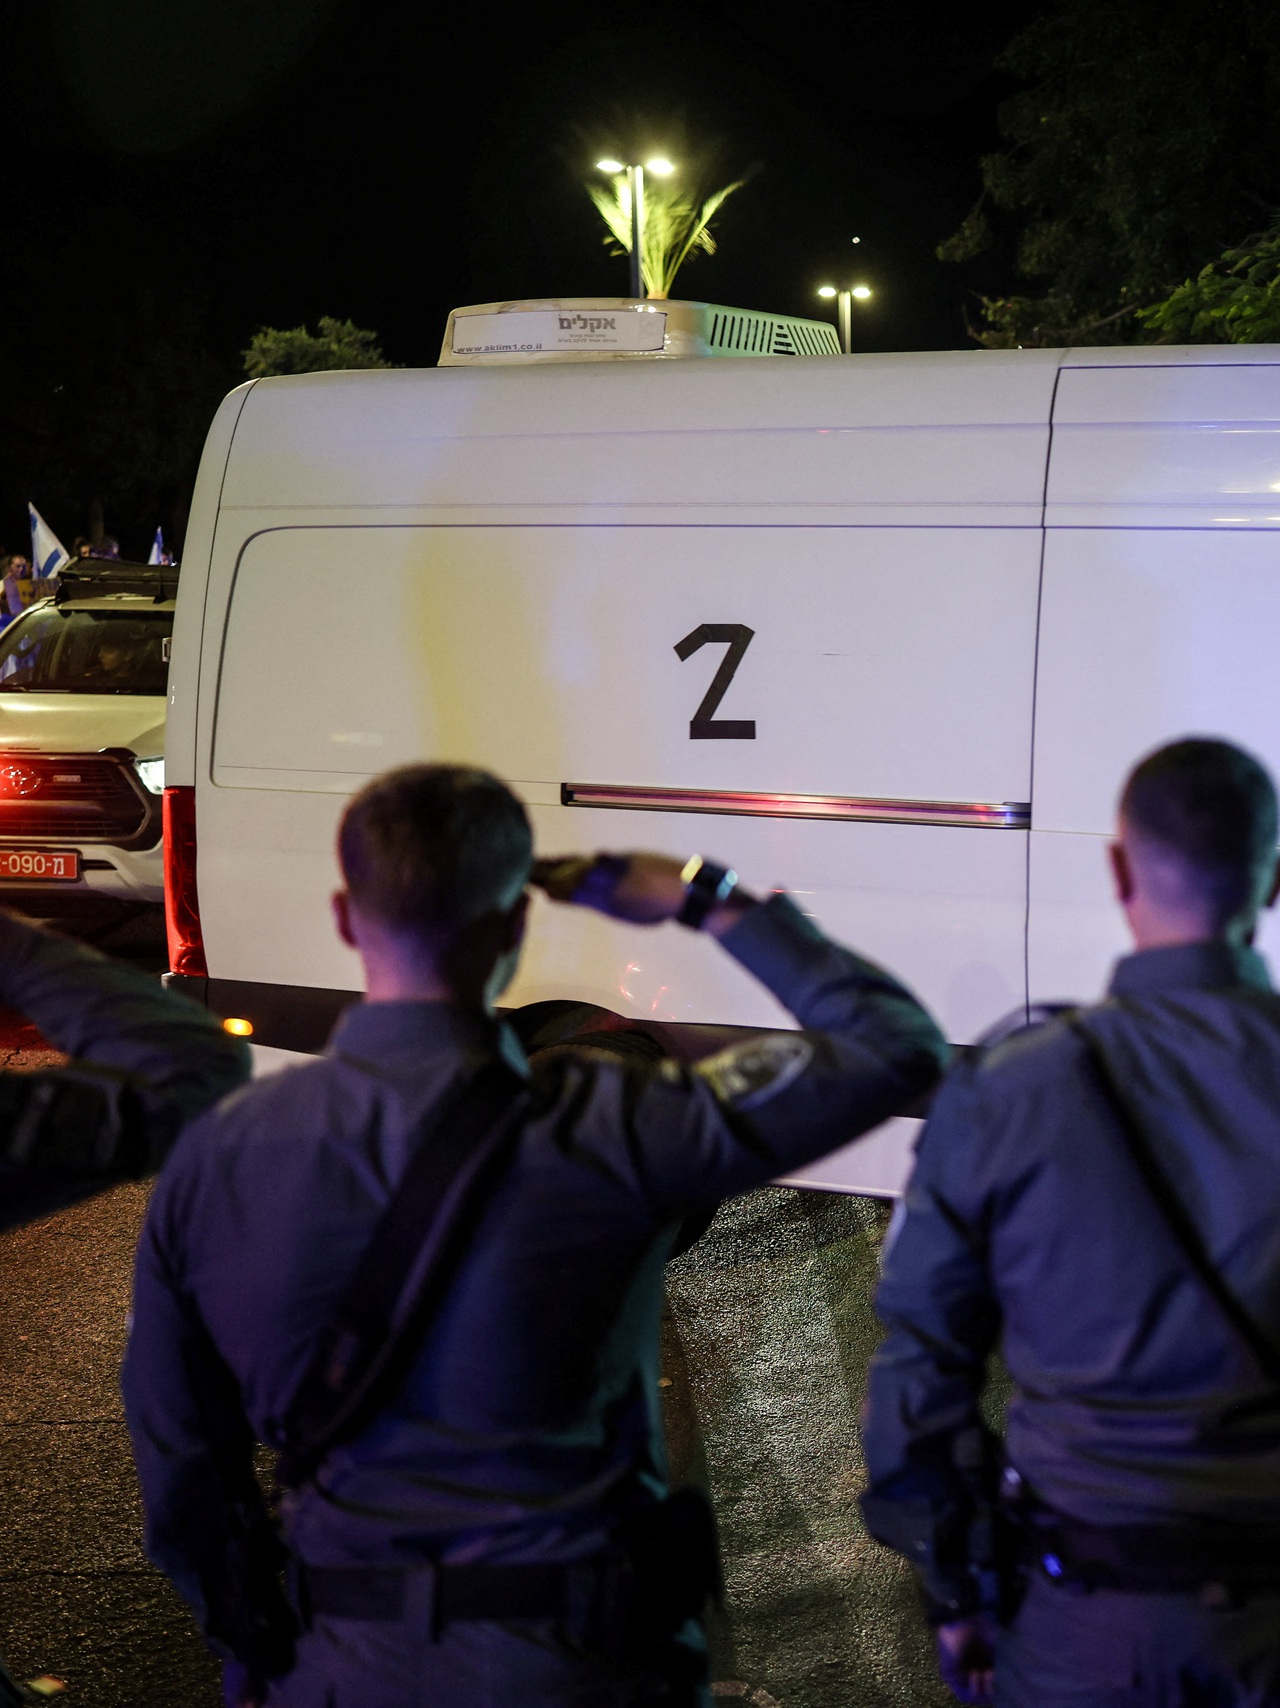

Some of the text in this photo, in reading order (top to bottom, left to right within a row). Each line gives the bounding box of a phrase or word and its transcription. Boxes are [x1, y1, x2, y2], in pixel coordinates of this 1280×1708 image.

[558, 314, 616, 333] אקלים
[457, 343, 543, 353] www.aklim1.co.il
[673, 623, 756, 739] 2
[0, 854, 65, 875] -090-מ
